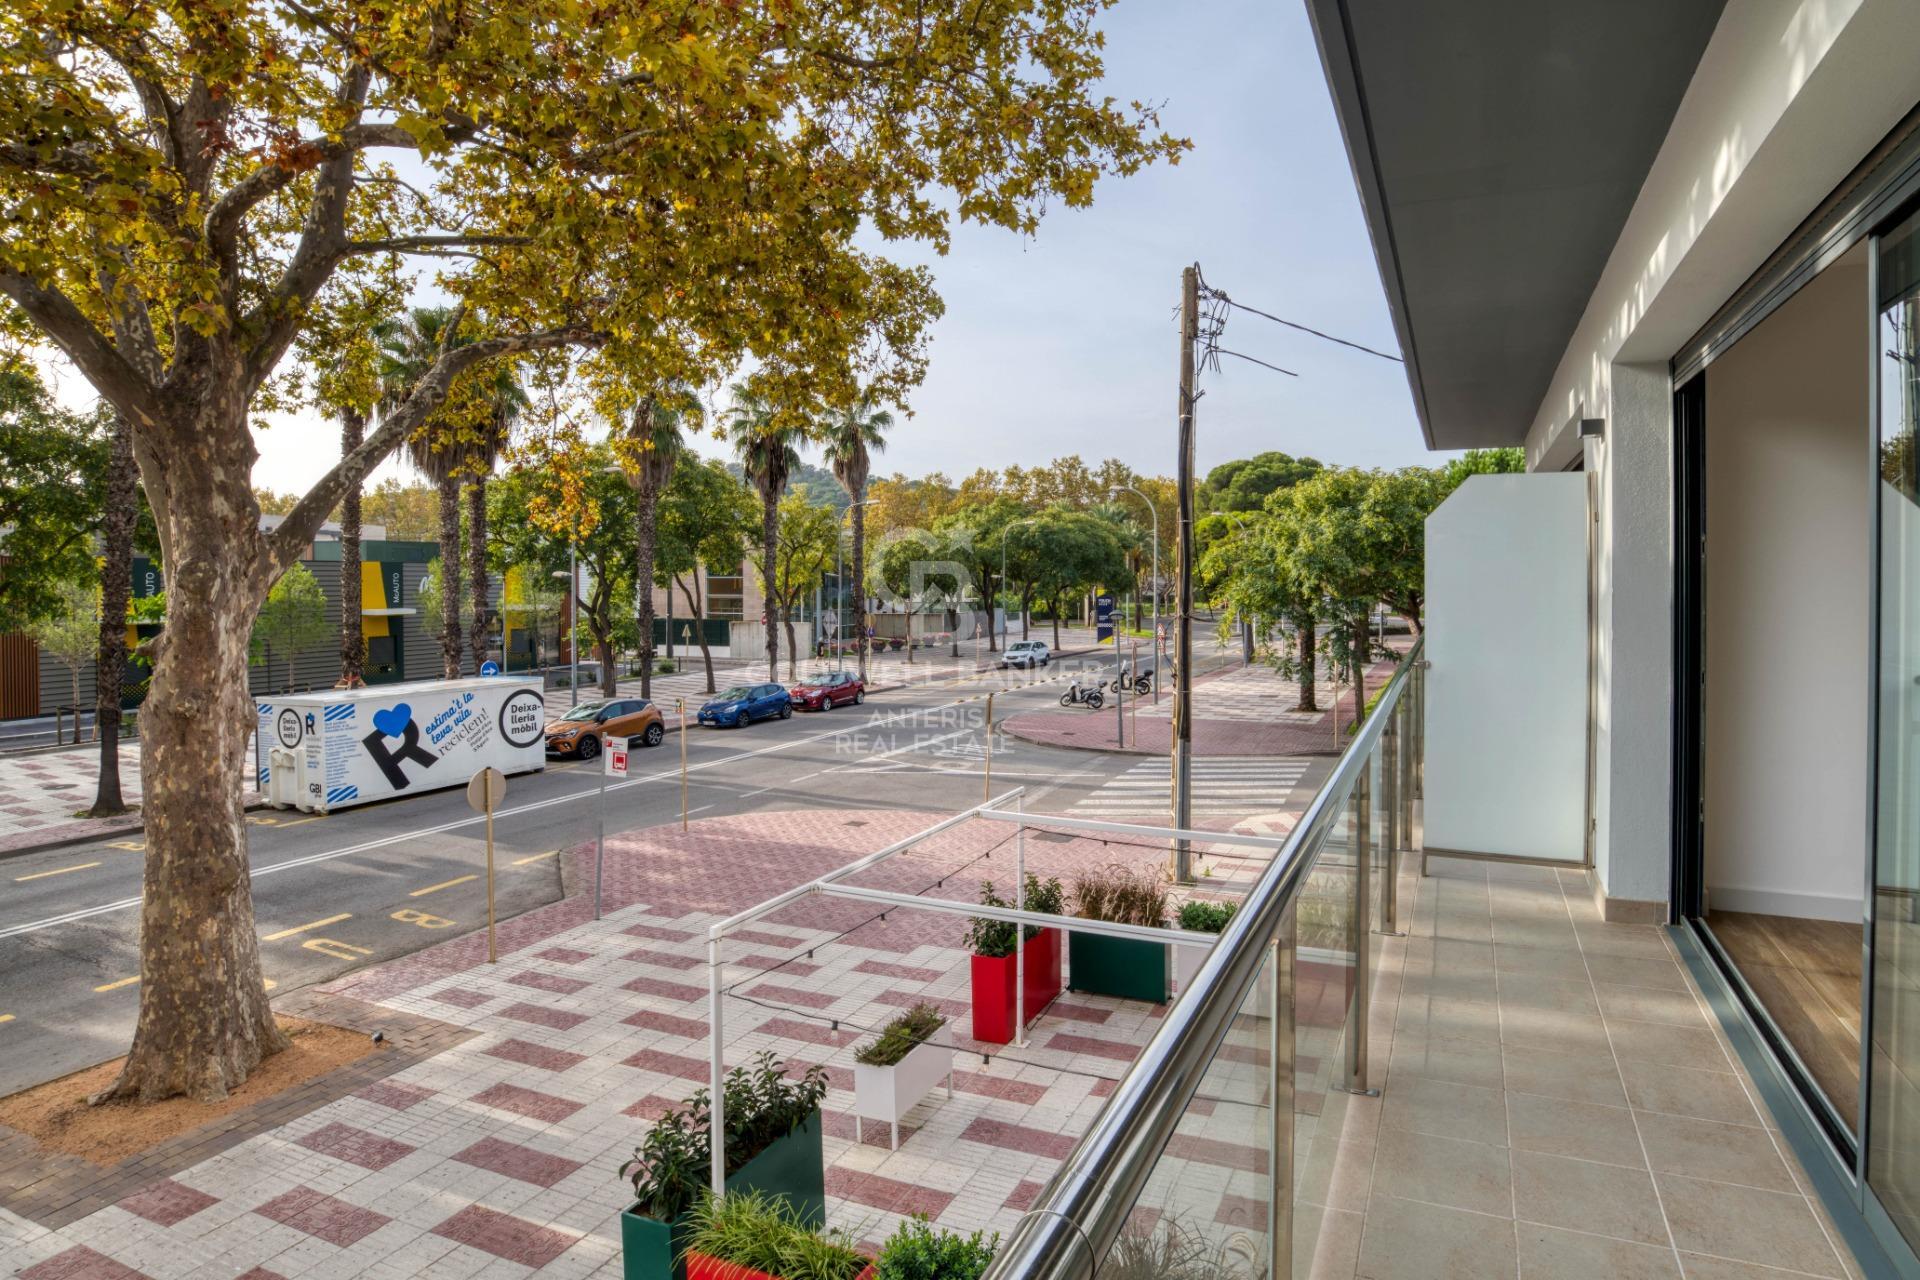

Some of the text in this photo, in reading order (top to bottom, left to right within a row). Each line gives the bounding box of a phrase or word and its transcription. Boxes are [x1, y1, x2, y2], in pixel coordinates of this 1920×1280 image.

[145, 572, 155, 597] AUTO
[463, 692, 474, 704] la
[511, 704, 541, 713] Deixa-
[454, 709, 472, 726] vila
[511, 713, 535, 724] lleria
[438, 707, 489, 756] reciclem!
[511, 722, 537, 734] mòbil
